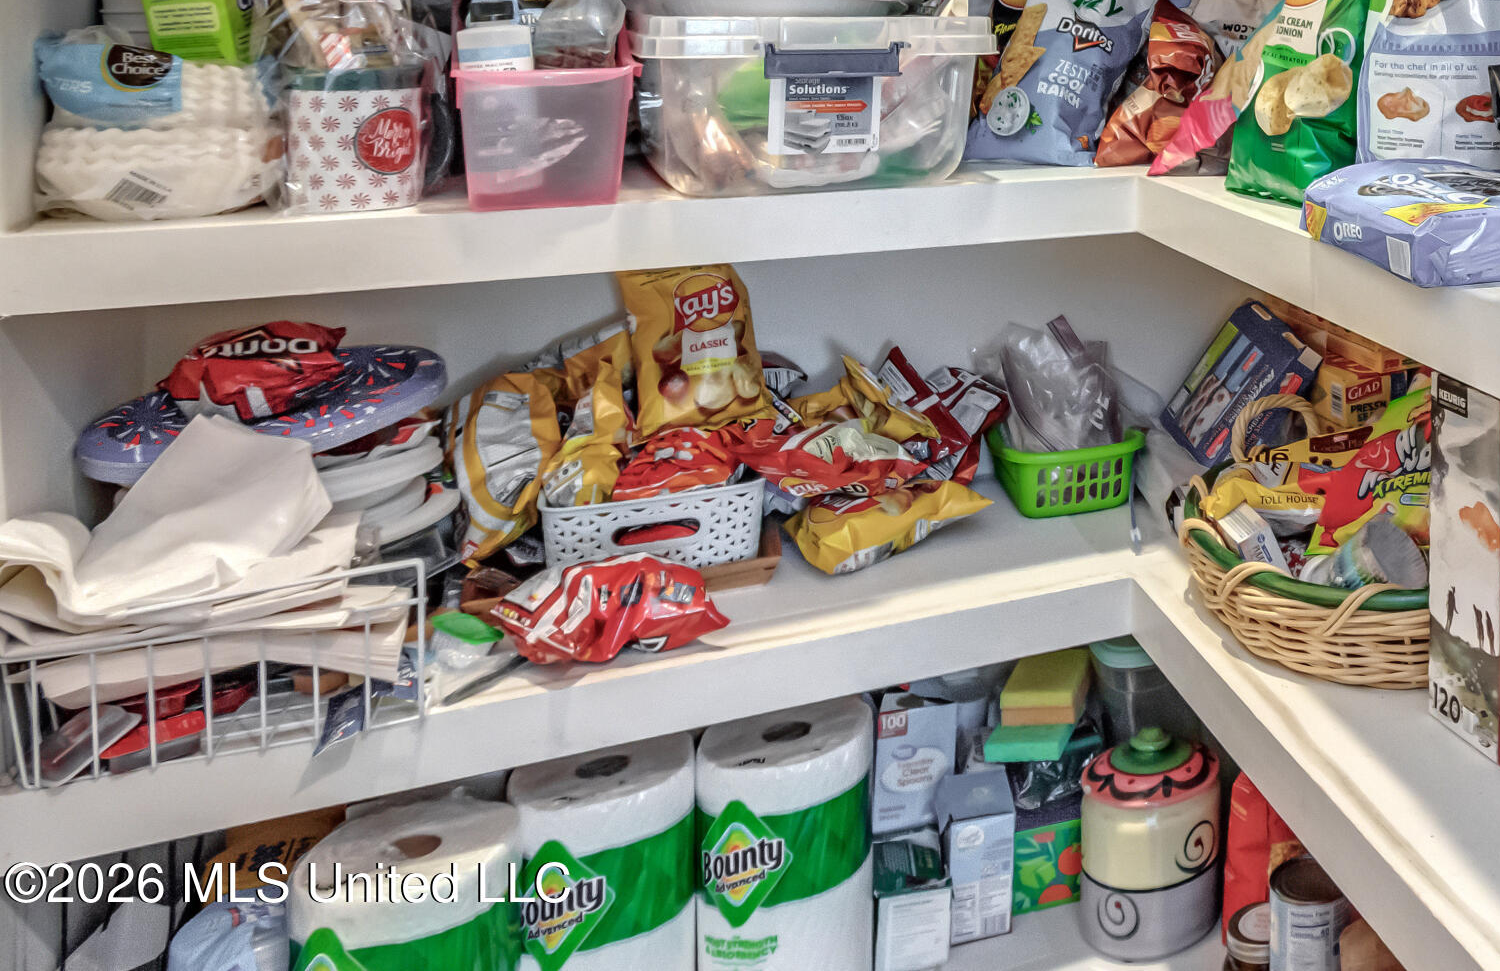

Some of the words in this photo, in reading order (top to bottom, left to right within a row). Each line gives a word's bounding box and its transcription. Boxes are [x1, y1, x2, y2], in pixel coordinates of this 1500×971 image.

[1286, 16, 1313, 30] CREAM
[1056, 17, 1115, 54] Doritos
[122, 52, 157, 65] Best
[1055, 59, 1090, 78] ZESTY
[1374, 59, 1387, 70] For
[1390, 60, 1404, 70] the
[1407, 61, 1427, 71] chef
[1430, 62, 1439, 71] in
[1441, 62, 1452, 71] all
[1455, 63, 1464, 71] of
[111, 63, 165, 77] Choice
[789, 83, 848, 95] Solutions
[1048, 72, 1085, 94] COOL
[1036, 81, 1080, 109] RANCH
[1334, 221, 1363, 241] OREO
[674, 282, 734, 325] Lay's
[203, 338, 318, 358] Dorit
[689, 337, 729, 353] CLASSIC
[1346, 380, 1382, 402] GLAD
[1438, 387, 1466, 409] KEURIG
[1372, 471, 1431, 499] XTREM
[1260, 494, 1283, 505] TOLL
[1286, 494, 1319, 505] HOUSE
[1432, 683, 1463, 725] 120
[880, 713, 907, 729] 100
[702, 838, 785, 886] Bounty
[715, 869, 767, 895] Advanced
[526, 912, 583, 941] Advanced
